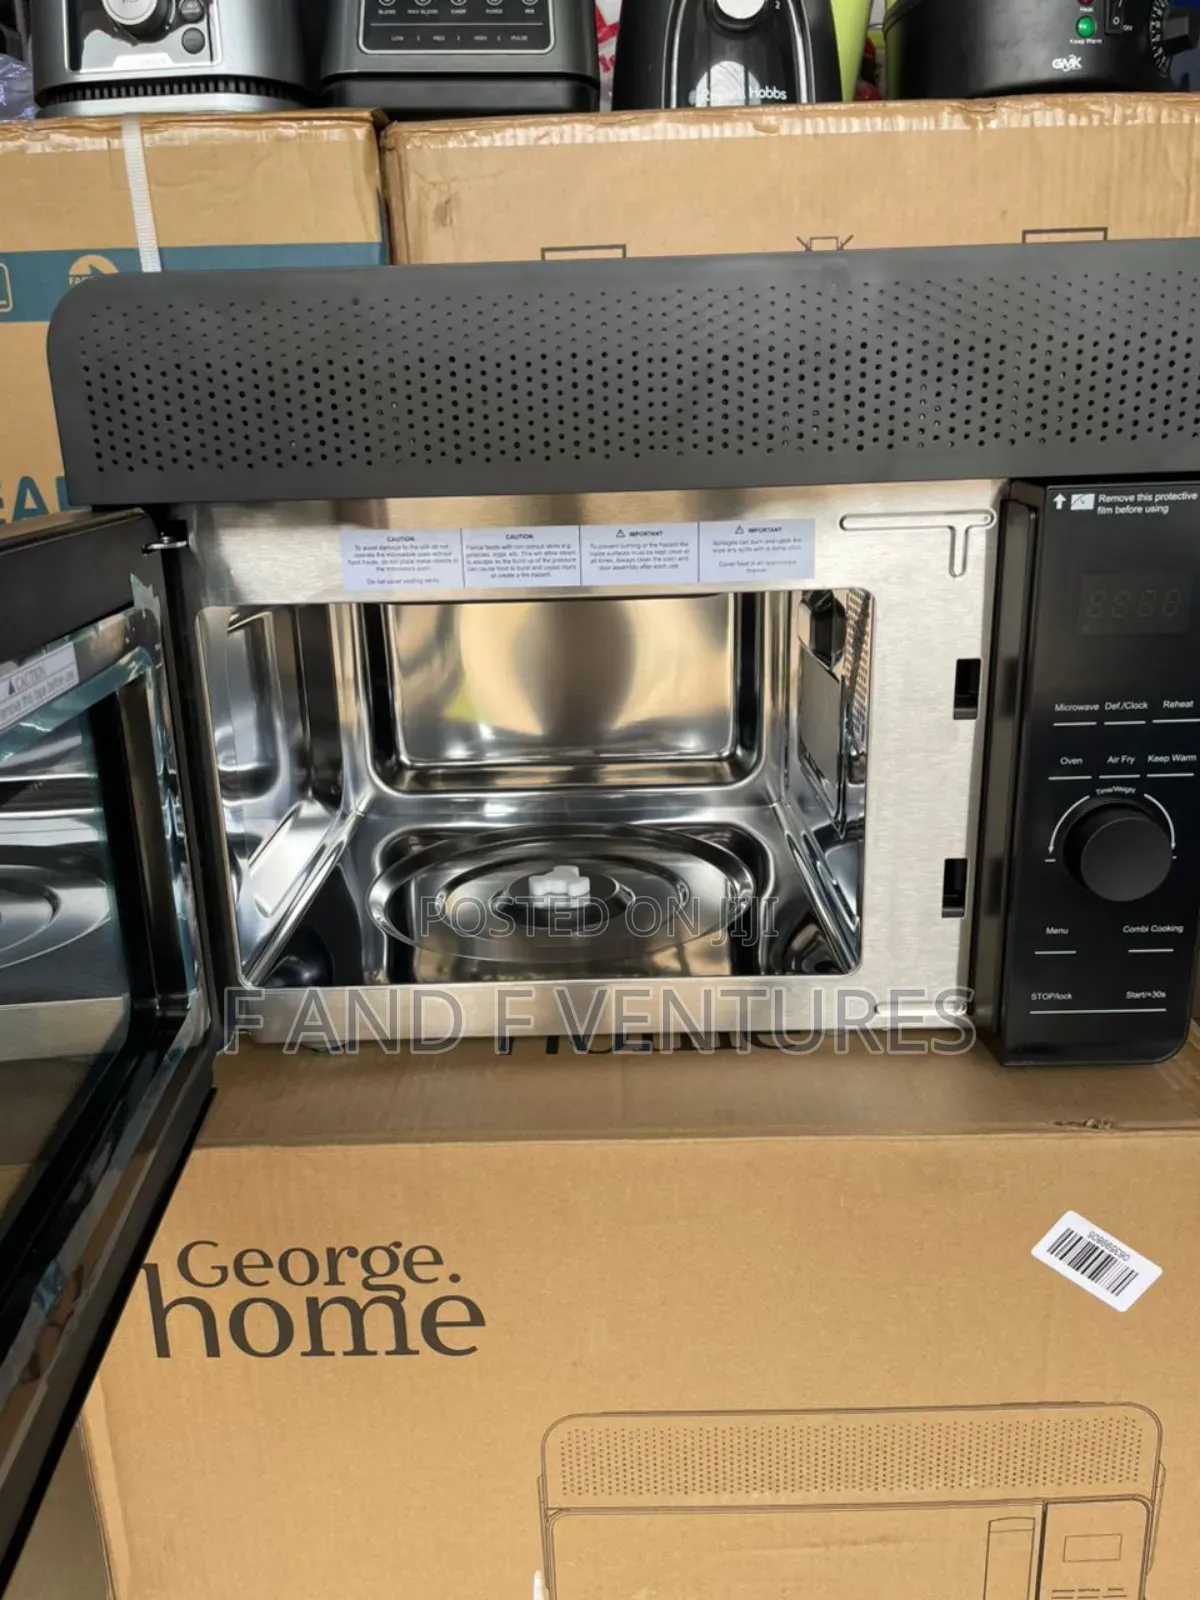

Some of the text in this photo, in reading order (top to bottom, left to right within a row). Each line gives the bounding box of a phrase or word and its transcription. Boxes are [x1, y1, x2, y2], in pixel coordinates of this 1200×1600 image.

[748, 85, 788, 101] Hobbs
[1099, 492, 1198, 502] Remove this protective
[1097, 506, 1113, 514] film
[1145, 505, 1169, 514] using
[1055, 703, 1099, 711] Microwave
[1163, 700, 1194, 709] Reheat
[1060, 757, 1083, 765] Oven
[1107, 755, 1135, 764] Air Fry
[1148, 755, 1170, 763] Keep
[1046, 926, 1069, 935] Menu
[1123, 925, 1184, 933] Combi Cooking
[140, 1262, 486, 1358] home
